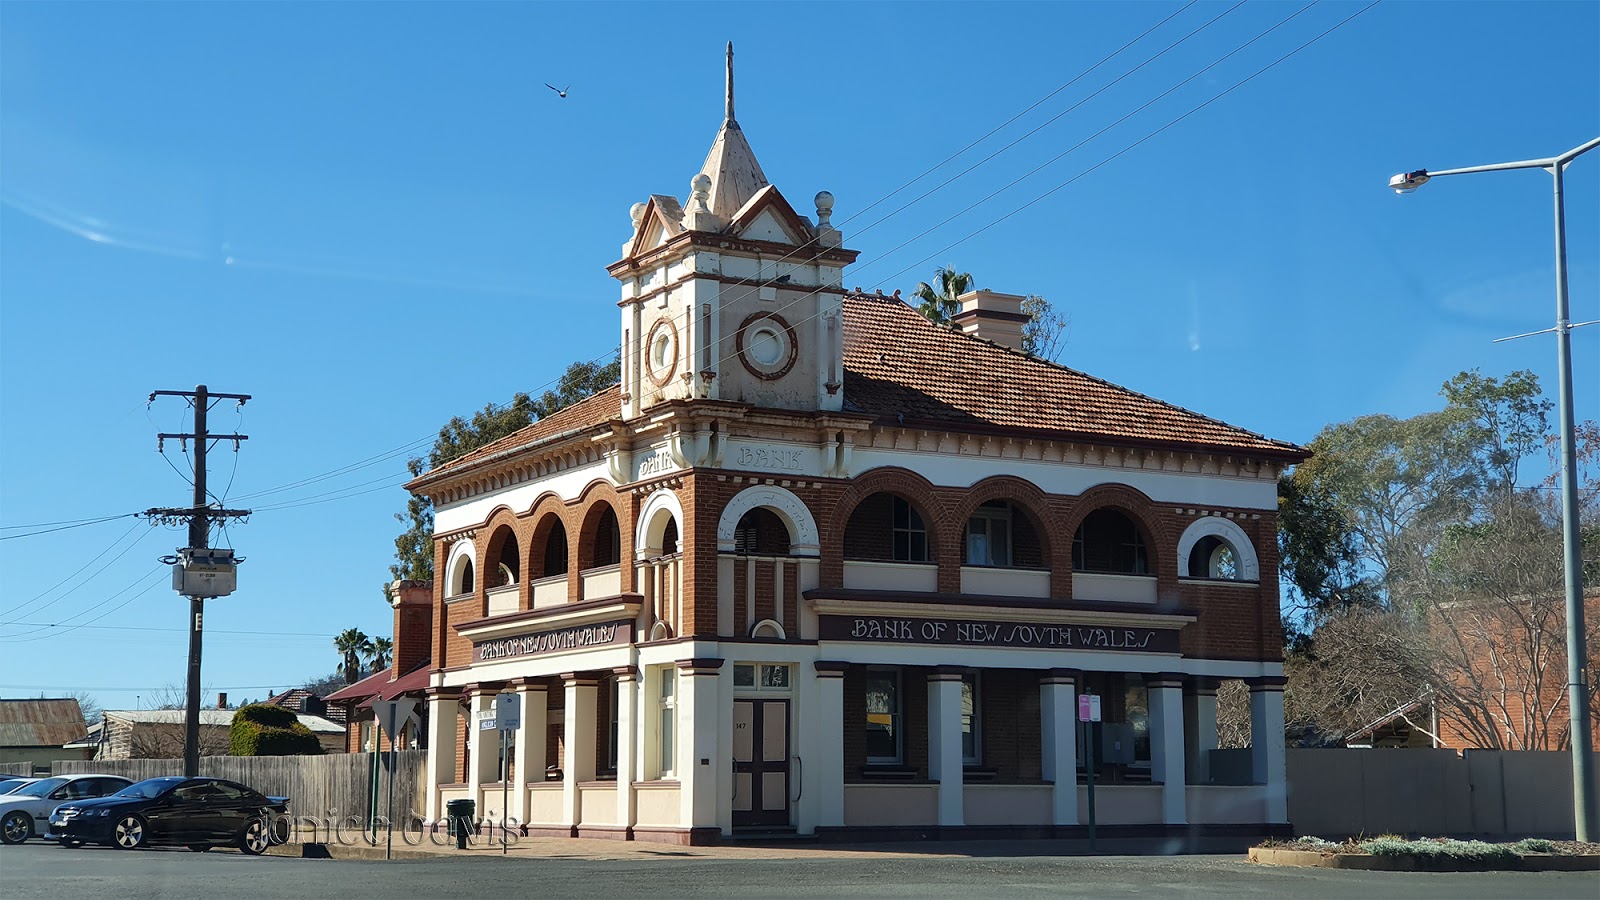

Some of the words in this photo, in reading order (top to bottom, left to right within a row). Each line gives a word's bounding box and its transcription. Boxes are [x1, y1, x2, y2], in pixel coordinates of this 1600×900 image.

[640, 450, 673, 475] BANK
[738, 447, 804, 471] BANK
[480, 642, 506, 660] BANK
[506, 639, 519, 656] OF
[520, 635, 541, 655] NEW
[578, 622, 618, 646] WALES
[851, 618, 914, 640] BANK
[921, 621, 948, 641] OF
[956, 622, 1002, 643] NEW
[1078, 628, 1155, 649] WALES
